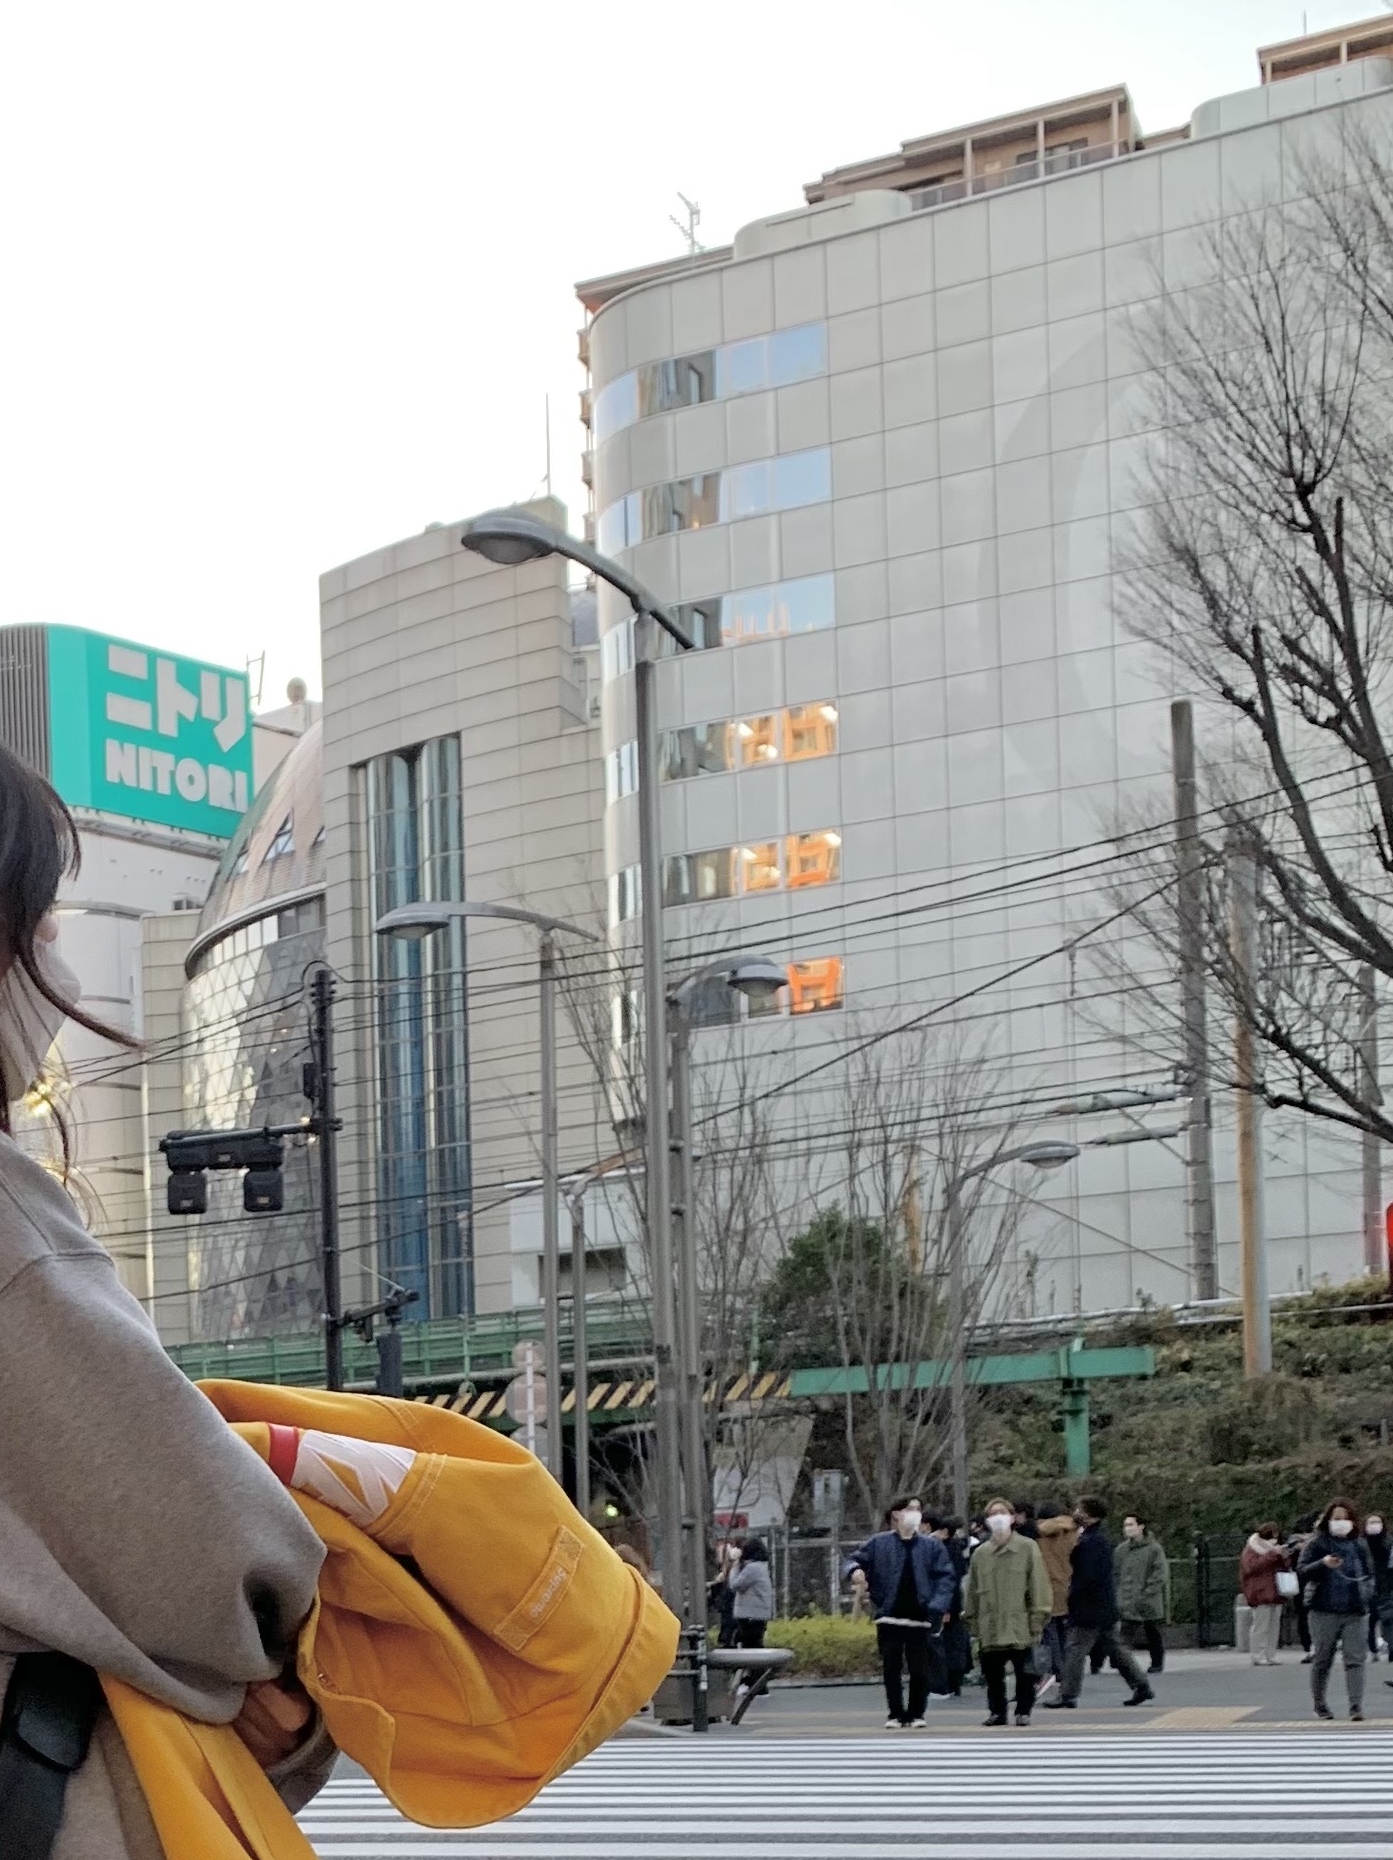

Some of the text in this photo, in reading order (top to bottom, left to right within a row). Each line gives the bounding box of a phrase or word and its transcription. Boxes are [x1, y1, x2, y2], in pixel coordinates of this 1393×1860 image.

[106, 643, 246, 754] ニトリ
[105, 738, 249, 814] NITORI
